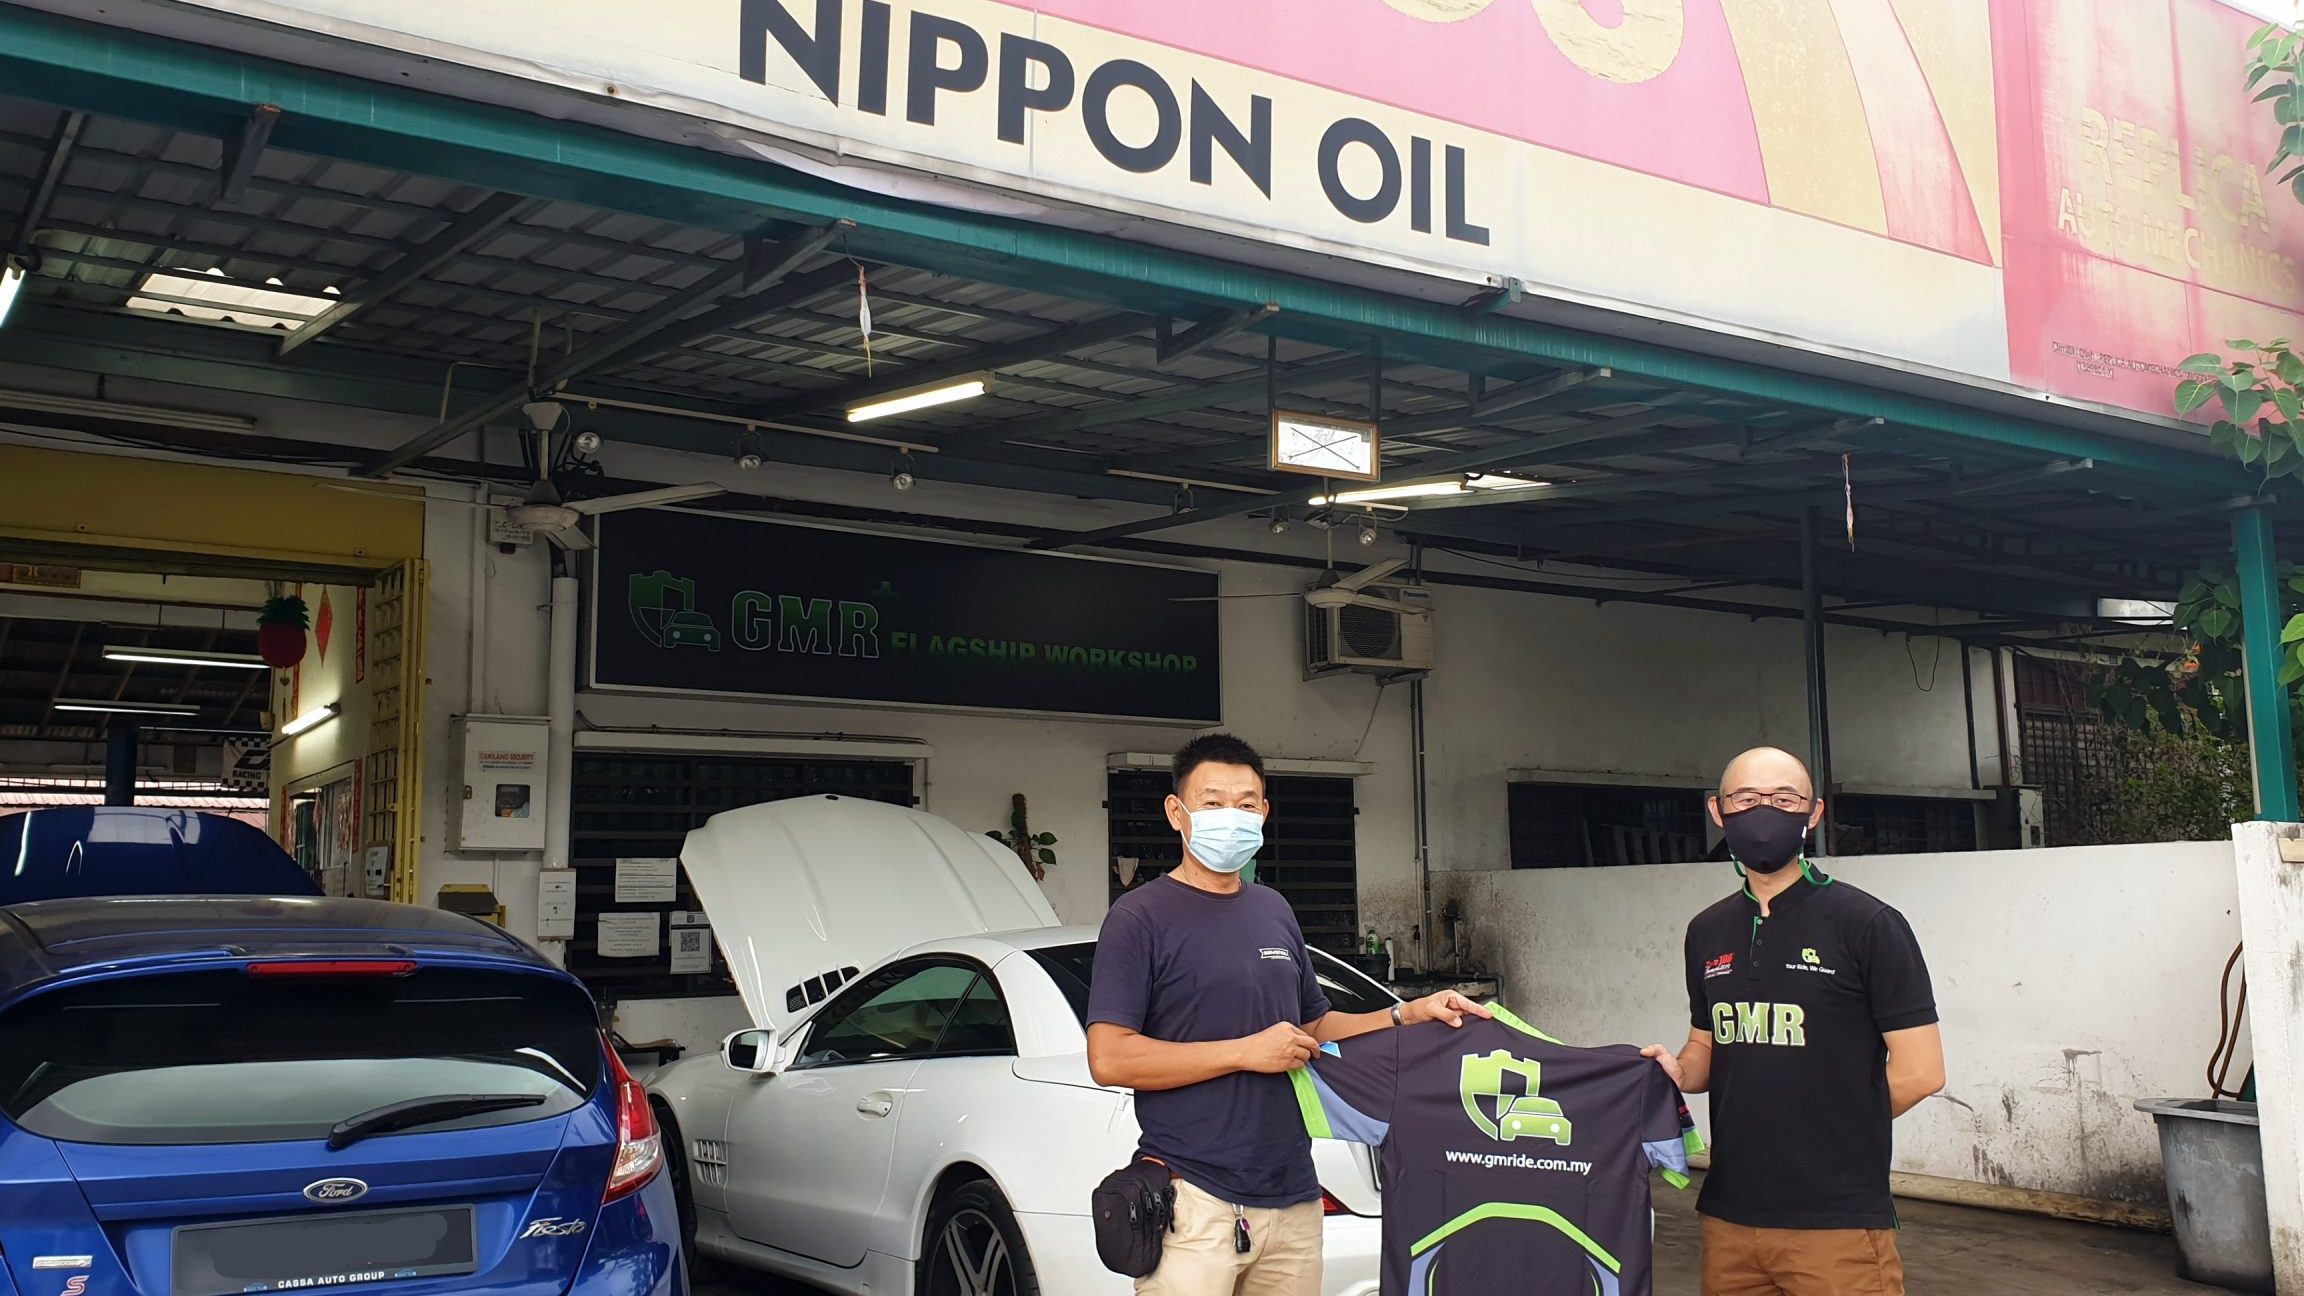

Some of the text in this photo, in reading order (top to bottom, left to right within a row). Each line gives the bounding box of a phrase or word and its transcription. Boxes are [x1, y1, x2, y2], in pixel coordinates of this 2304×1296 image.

[740, 0, 1272, 201] NIPPON
[1318, 117, 1490, 246] OIL
[731, 589, 880, 659] GMR
[890, 630, 1198, 674] FLAGSHIP WORKSHOP
[232, 769, 261, 780] RACING
[1712, 1001, 1806, 1046] GMR
[1446, 1150, 1592, 1176] www.gmride.com.my
[318, 1183, 354, 1198] Ford
[519, 1217, 587, 1240] Fiesta
[277, 1271, 385, 1289] CASSA AUTO GROUP
